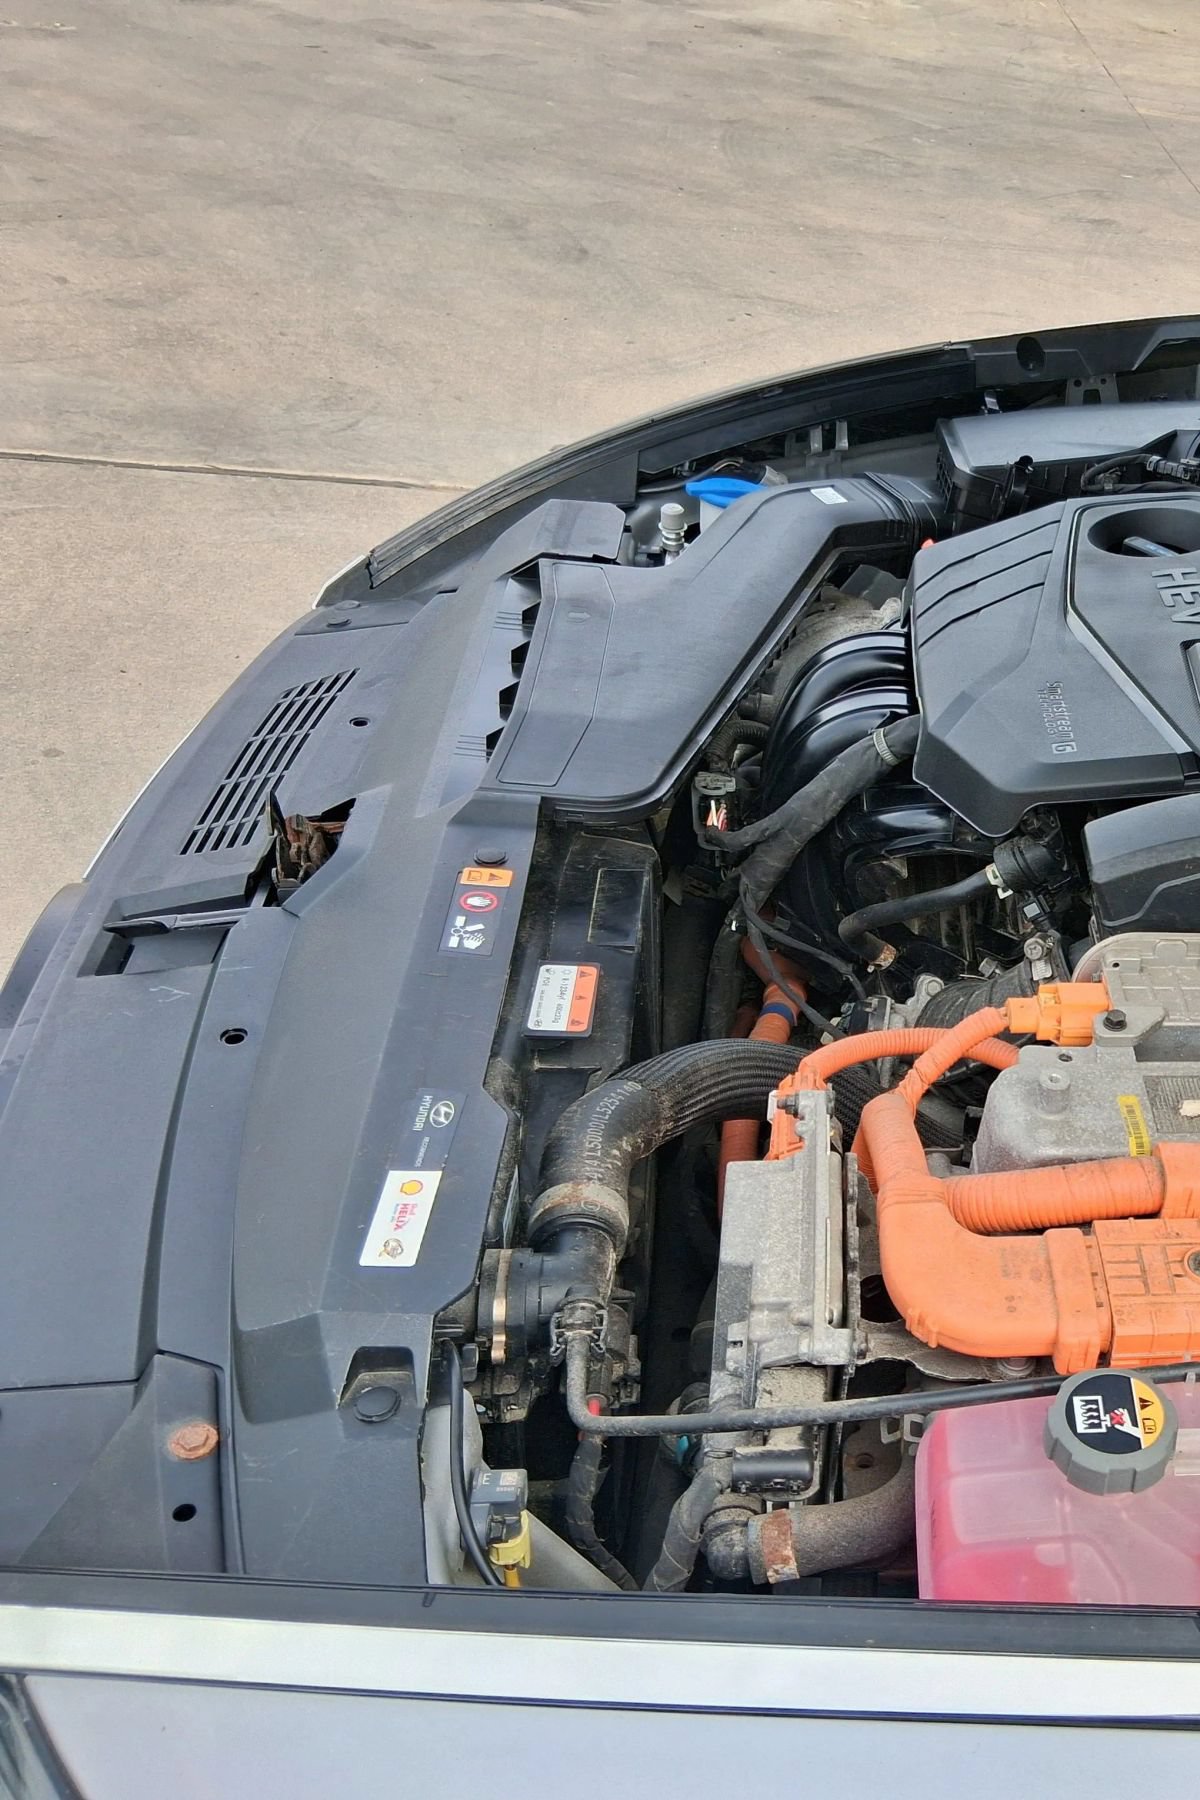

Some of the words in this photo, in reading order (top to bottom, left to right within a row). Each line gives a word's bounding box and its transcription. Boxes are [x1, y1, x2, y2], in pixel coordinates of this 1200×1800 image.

[1037, 689, 1059, 738] TECHNOLOGY
[1046, 681, 1074, 739] Smartstream
[412, 1095, 434, 1131] HYUNDAI
[394, 1203, 410, 1231] HELIX
